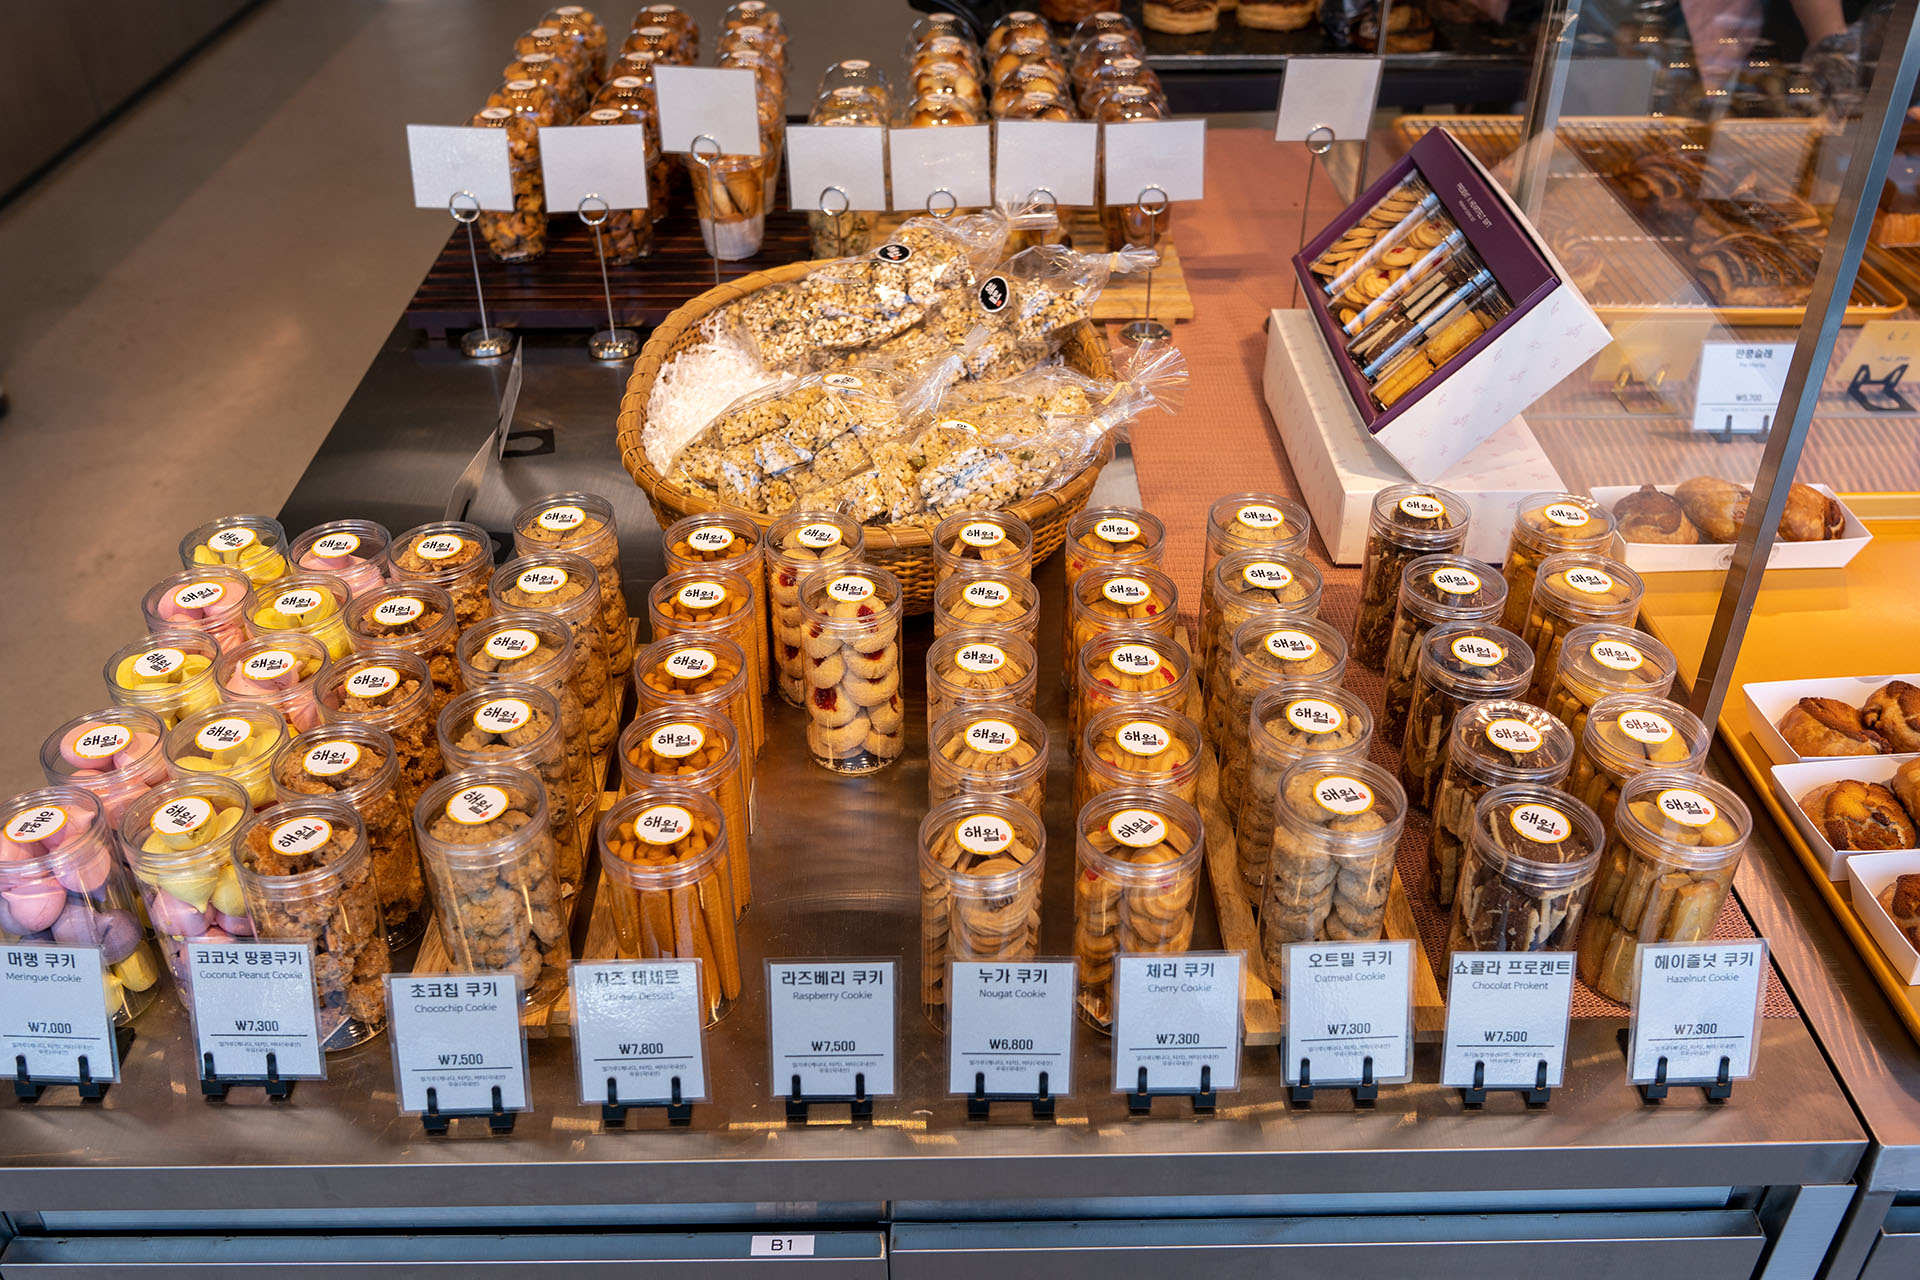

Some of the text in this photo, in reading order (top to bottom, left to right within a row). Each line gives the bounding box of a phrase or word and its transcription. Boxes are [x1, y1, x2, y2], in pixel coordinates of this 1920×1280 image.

[8, 952, 75, 968] 머랭 쿠키
[197, 951, 302, 965] 코코넛 땅콩쿠키
[1309, 951, 1391, 967] 오트밀 쿠키
[1655, 952, 1753, 969] 헤이즐넛 쿠키
[1147, 963, 1214, 978] 체리 쿠키
[1454, 961, 1572, 975] 쇼콜라 프로켄트
[6, 973, 82, 984] Meringue Cookie
[200, 971, 302, 980] Coconut Peanut Cookie
[594, 970, 680, 986] 치즈 데세르
[782, 970, 882, 985] 라즈베리 쿠키
[979, 969, 1047, 984] 누가 쿠키
[1314, 972, 1385, 984] Oatmeal Cookie
[1667, 973, 1739, 983] Hazelnut Cookie
[411, 982, 497, 998] 초코칩 쿠키
[1148, 984, 1212, 994] Cherry Cookie
[1472, 981, 1548, 990] Chocolat Prokent
[793, 991, 872, 1001] Raspberry Cookie
[979, 989, 1046, 1000] Nougat Cookie
[414, 1003, 497, 1013] Chocochip Cookie
[771, 1239, 792, 1251] B1
